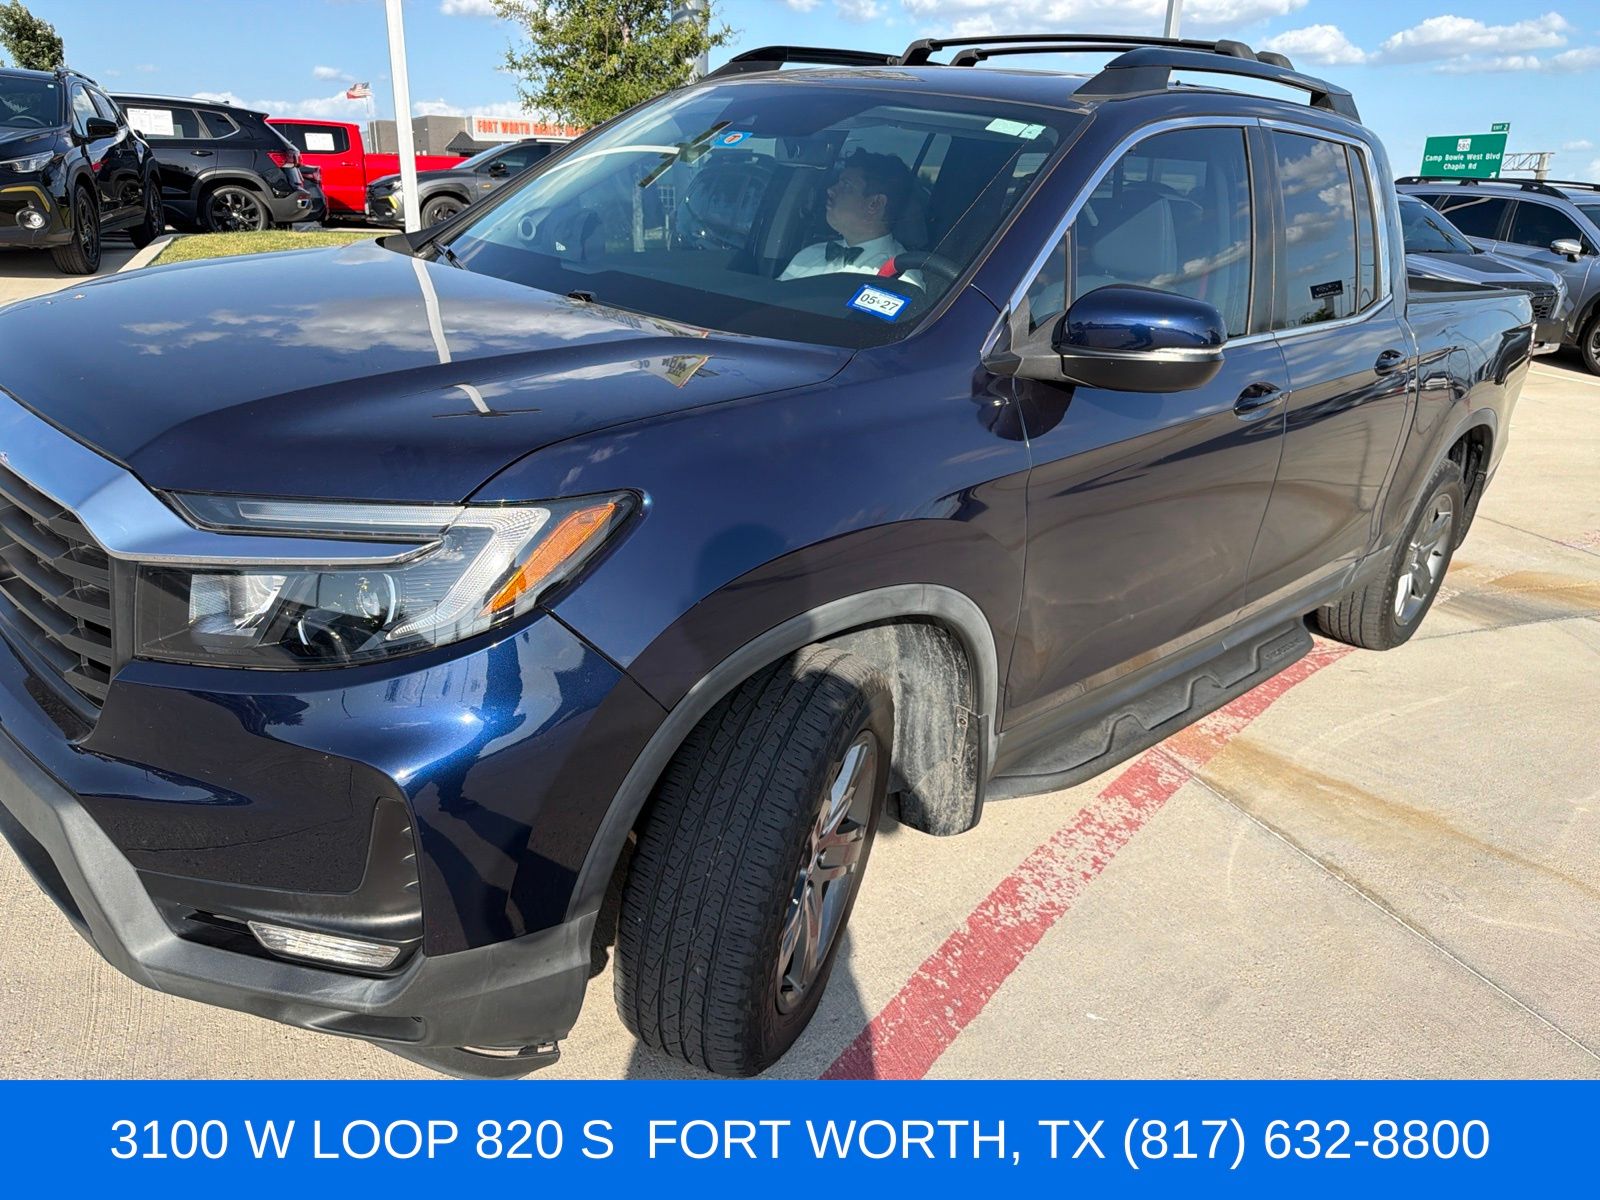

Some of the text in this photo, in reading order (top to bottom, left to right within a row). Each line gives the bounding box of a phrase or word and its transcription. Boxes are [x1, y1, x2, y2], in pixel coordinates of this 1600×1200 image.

[477, 120, 498, 133] FORT
[501, 121, 530, 135] WORTH
[1425, 154, 1442, 162] Camp
[1445, 153, 1464, 161] Bowie
[1485, 152, 1500, 160] Blvd
[1443, 162, 1477, 171] Chapin Rd
[860, 293, 899, 311] 05 27
